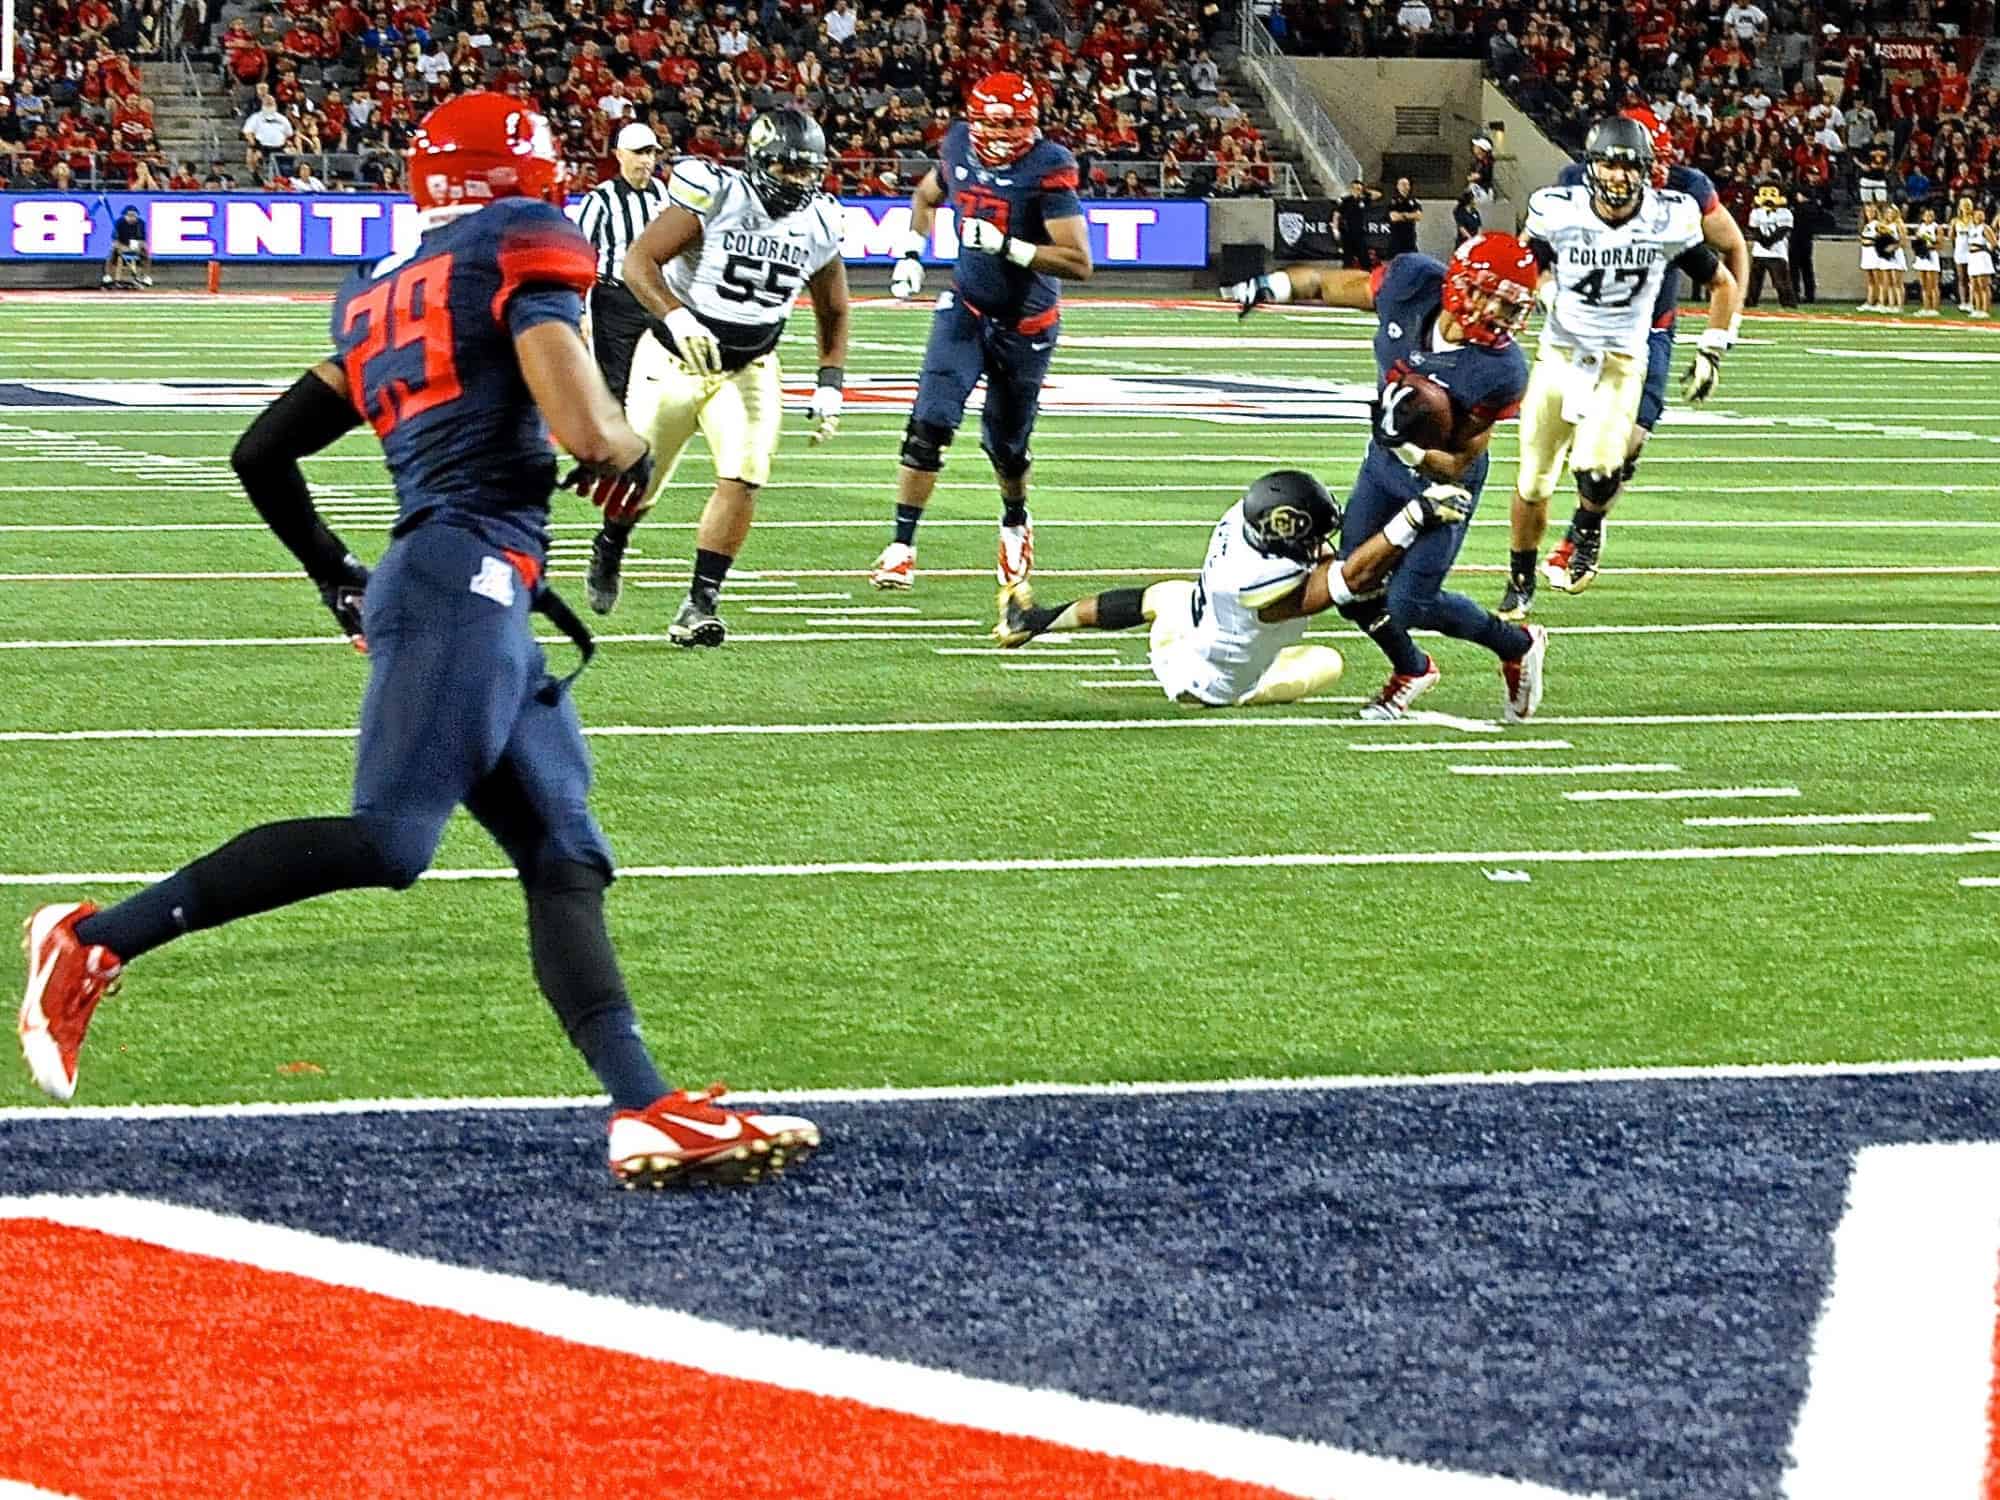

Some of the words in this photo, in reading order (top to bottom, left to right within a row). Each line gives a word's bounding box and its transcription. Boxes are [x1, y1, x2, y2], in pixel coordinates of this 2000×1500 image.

[1304, 221, 1392, 235] NERK
[722, 231, 811, 268] COLORADO
[1569, 246, 1657, 267] COLORADO
[716, 253, 801, 308] 55
[1570, 267, 1650, 308] 47
[344, 253, 464, 438] 29
